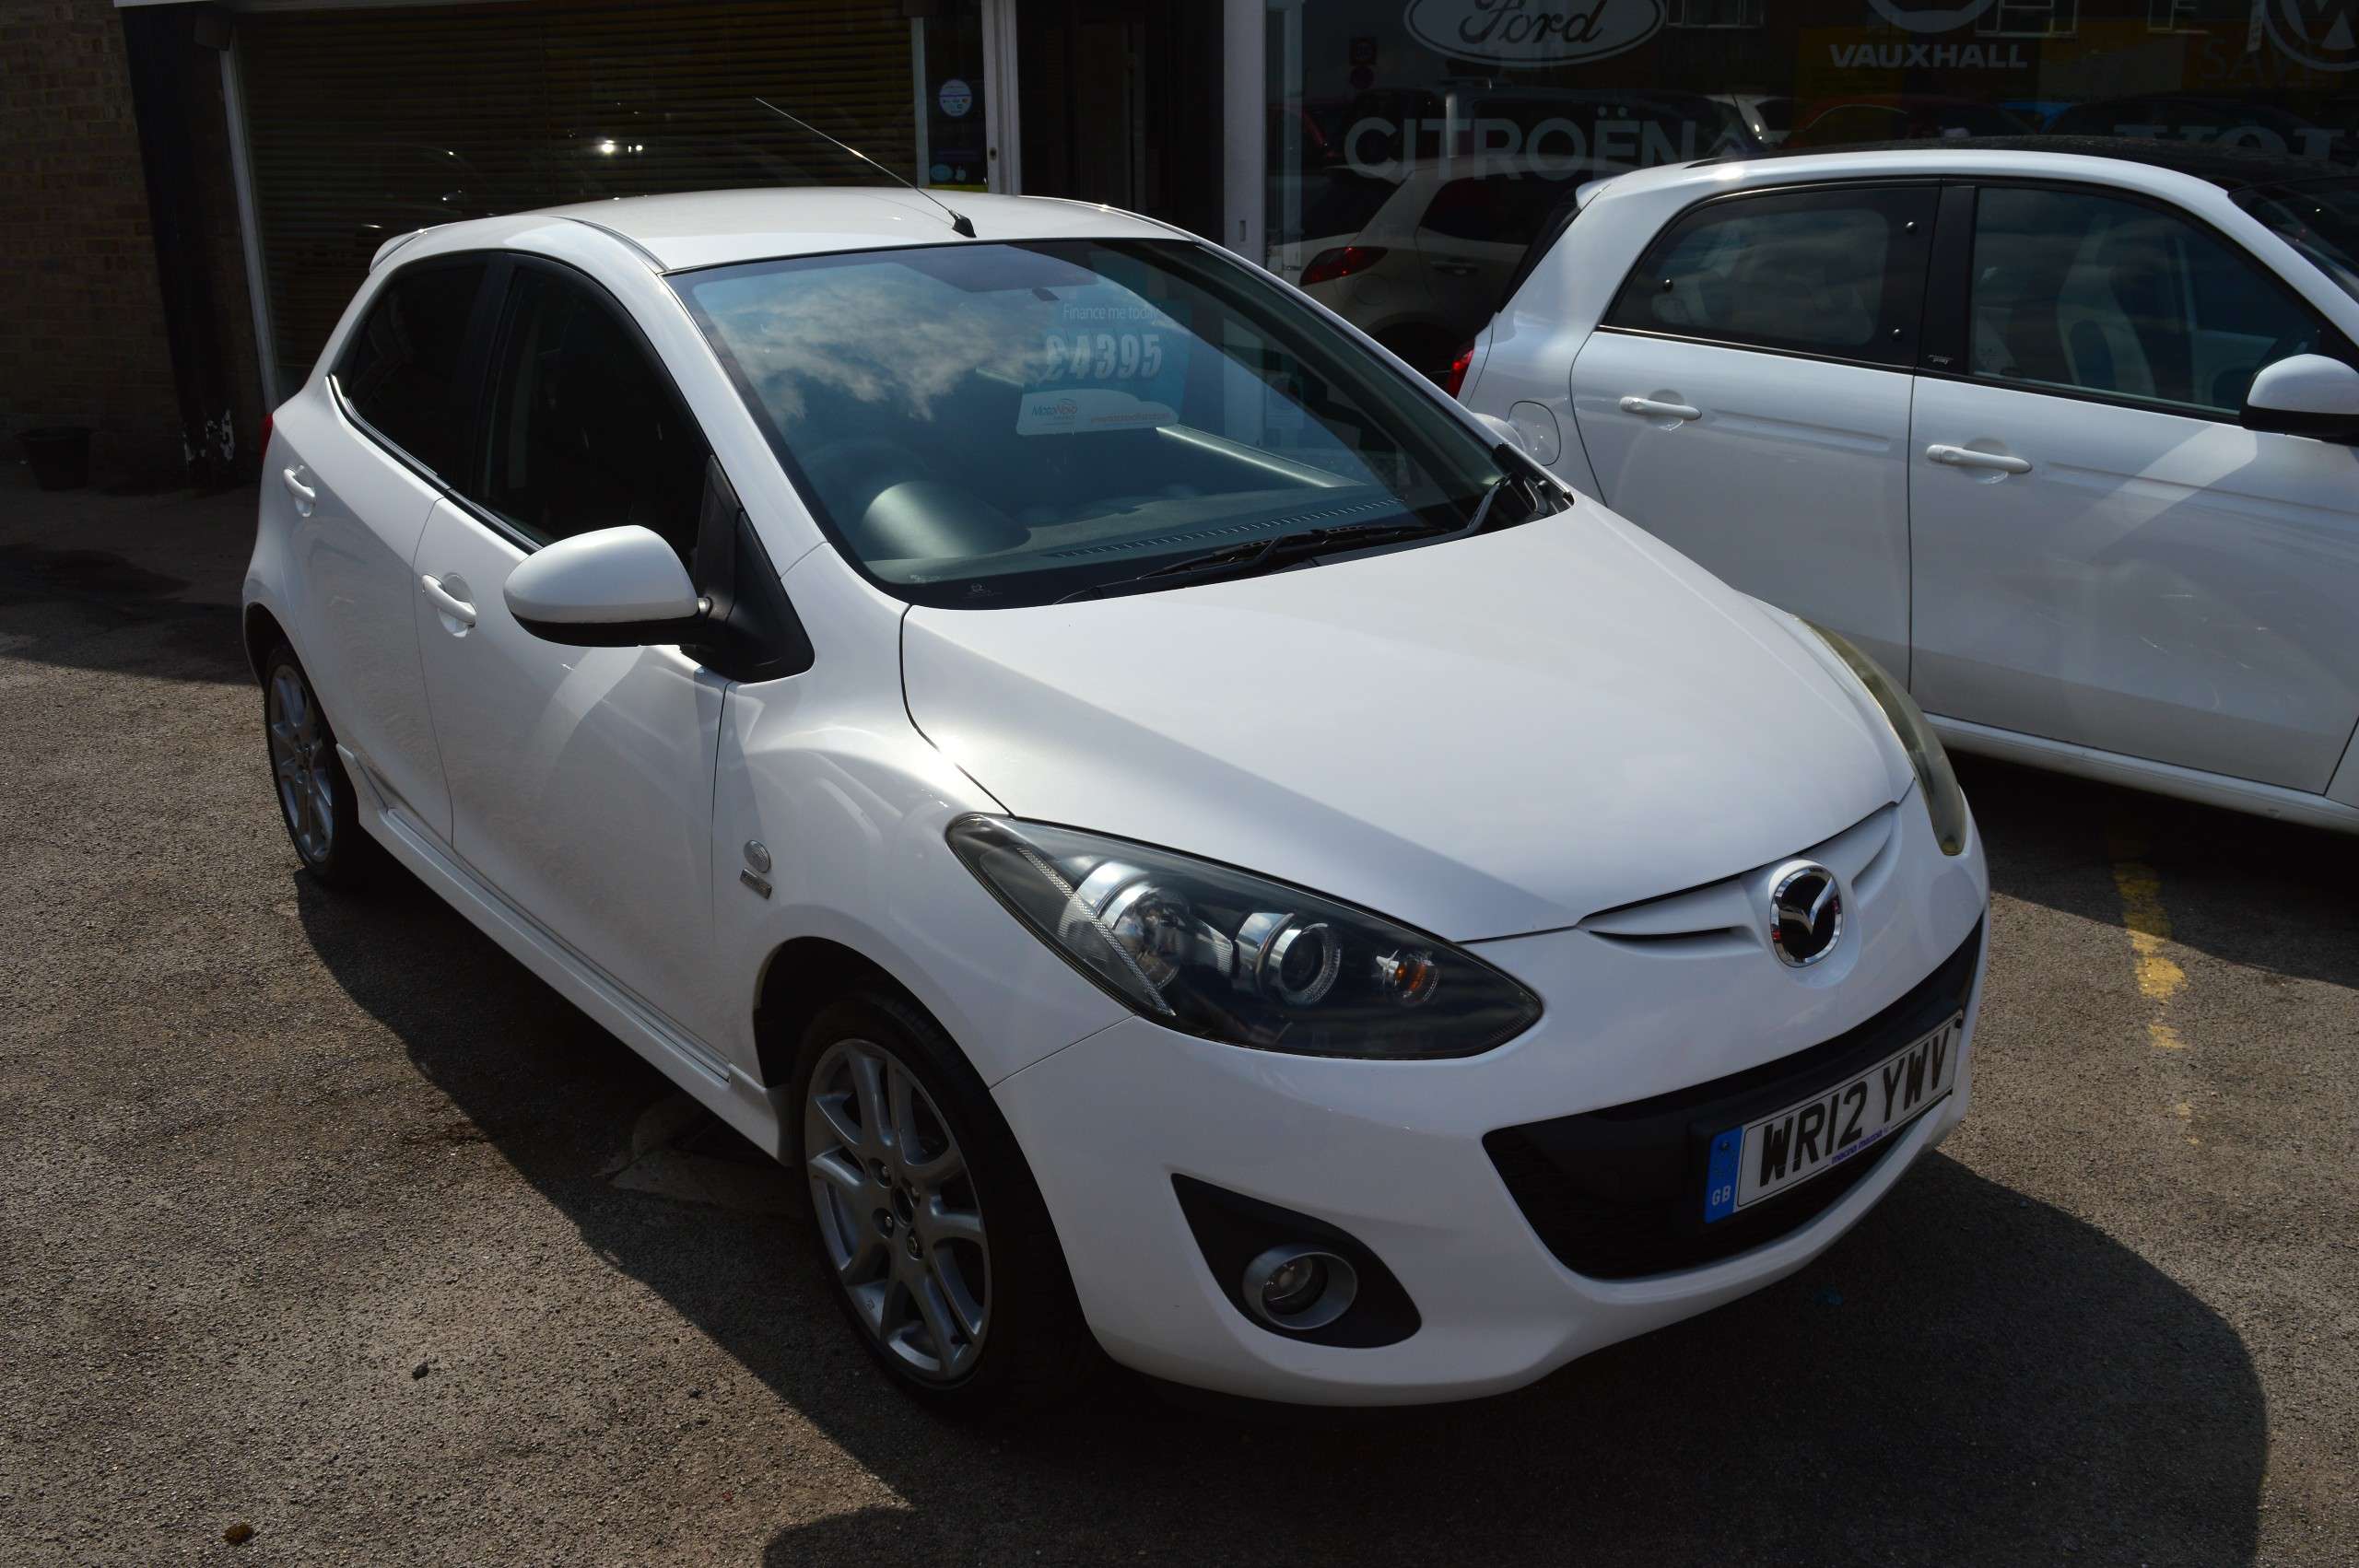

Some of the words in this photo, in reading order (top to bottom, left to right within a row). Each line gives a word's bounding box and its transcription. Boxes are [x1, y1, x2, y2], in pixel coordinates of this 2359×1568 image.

[1458, 0, 1605, 44] Ford
[1828, 43, 2028, 69] VAUXHALL
[1344, 105, 1696, 181] CITROËN
[1062, 302, 1106, 321] Finance
[1109, 308, 1125, 320] me
[1044, 333, 1162, 380] £4395
[1759, 1081, 1868, 1188] WR12
[1883, 1026, 1951, 1124] YWV
[1711, 1185, 1732, 1207] GB
